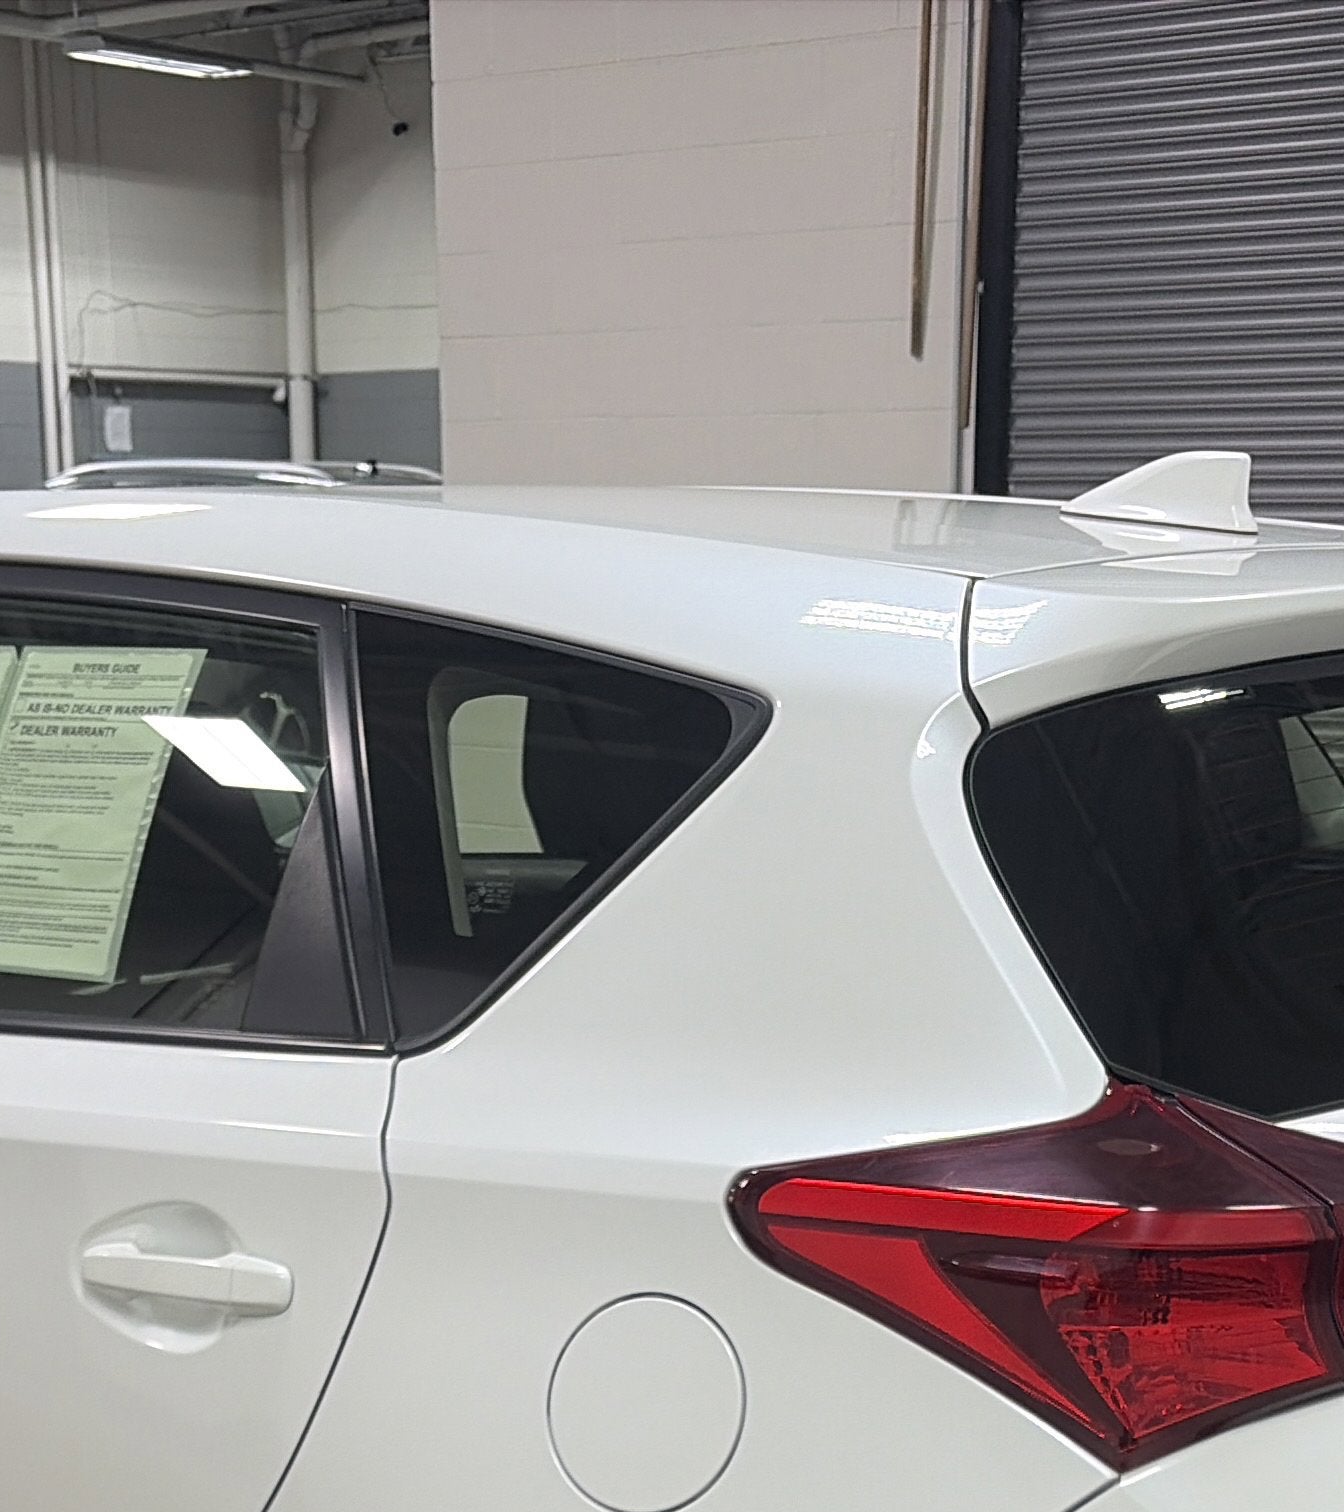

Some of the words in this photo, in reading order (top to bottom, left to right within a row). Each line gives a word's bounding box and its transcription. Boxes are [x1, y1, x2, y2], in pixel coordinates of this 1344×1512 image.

[73, 663, 109, 674] BUYERS
[111, 664, 141, 674] GUIDE
[27, 703, 41, 713] AS
[72, 704, 113, 714] DEALER
[115, 705, 173, 717] WARRANTY
[20, 725, 60, 735] DEALER
[62, 726, 118, 738] WARRANTY
